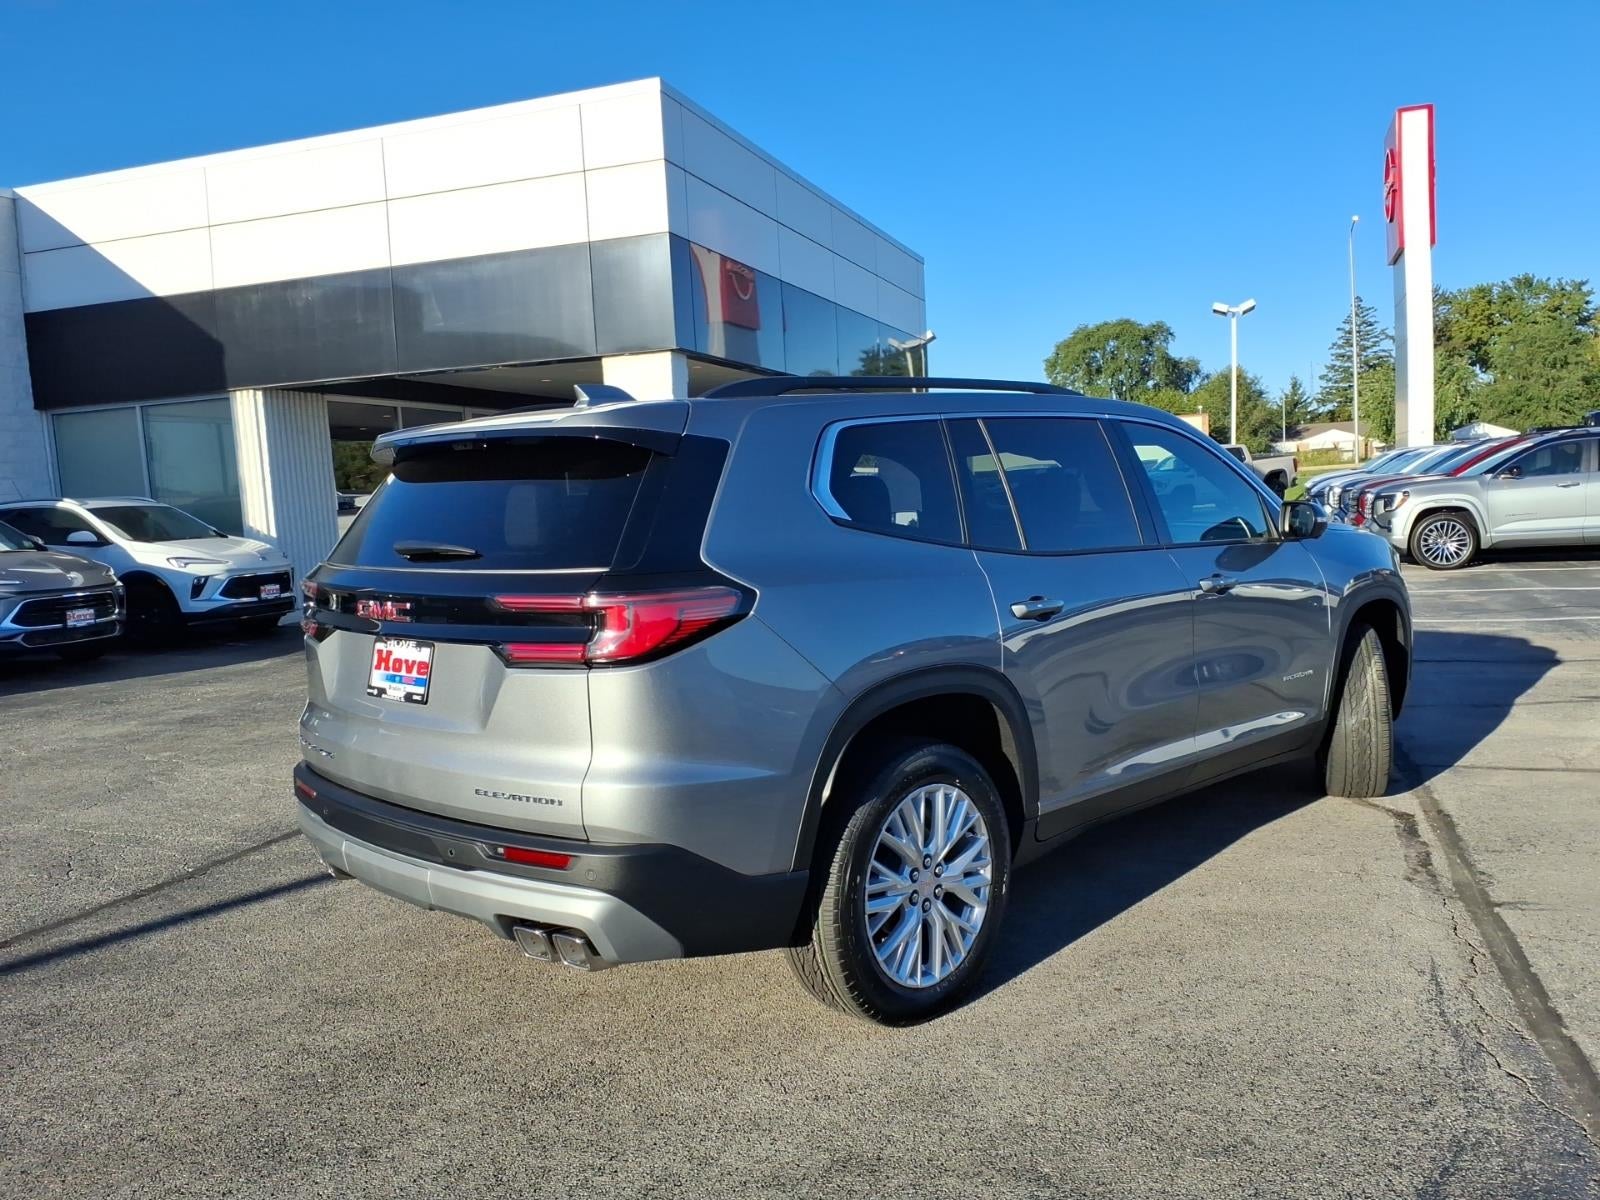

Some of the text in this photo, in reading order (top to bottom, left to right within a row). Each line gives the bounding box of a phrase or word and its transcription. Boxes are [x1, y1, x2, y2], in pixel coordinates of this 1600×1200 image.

[357, 600, 411, 622] GMC
[375, 649, 430, 676] Hove
[475, 788, 563, 806] ELEVATION
